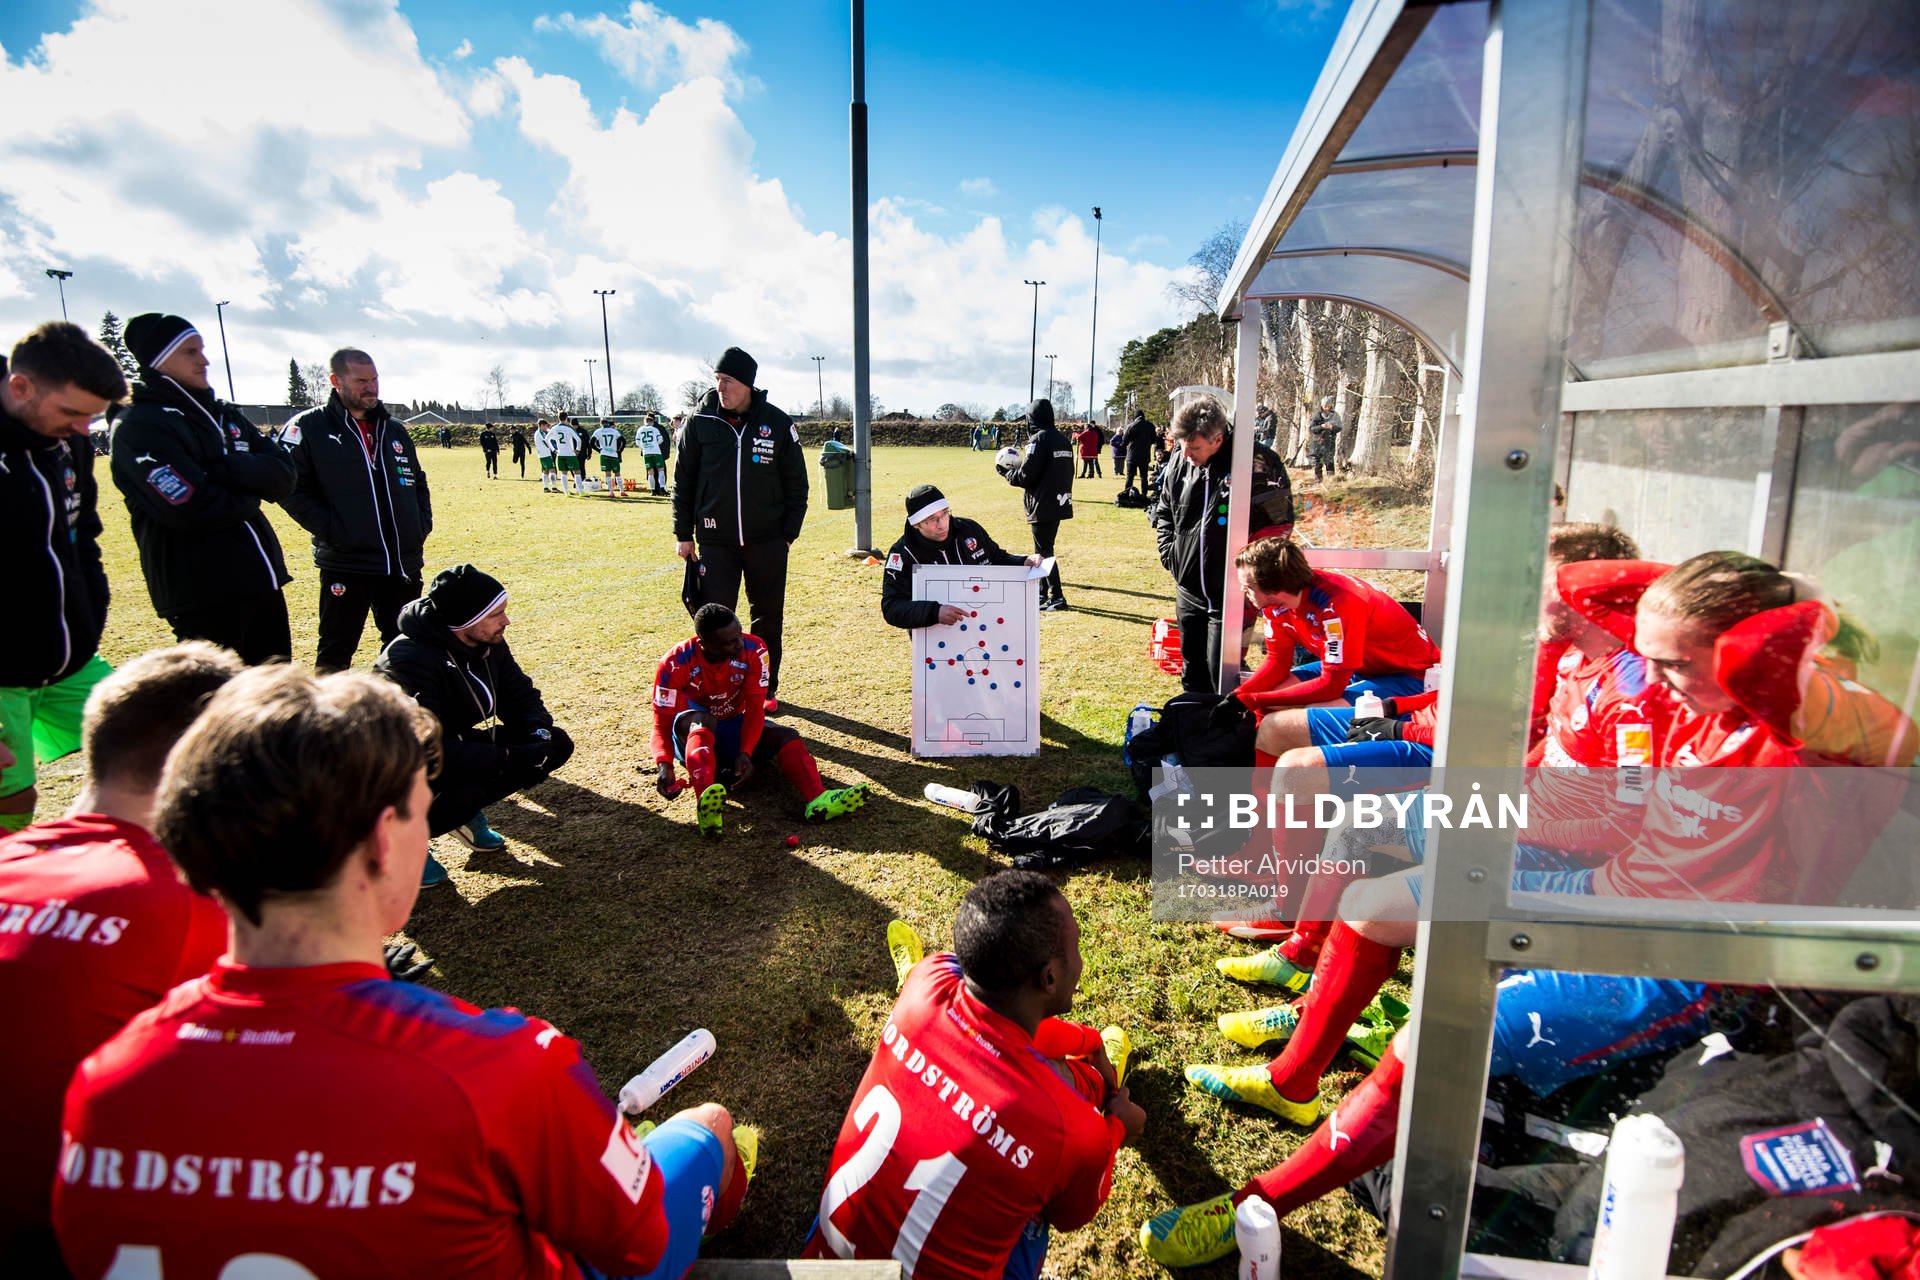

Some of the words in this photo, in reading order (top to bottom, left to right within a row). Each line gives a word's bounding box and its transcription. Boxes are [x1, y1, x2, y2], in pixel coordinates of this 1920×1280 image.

[558, 432, 566, 444] 2
[602, 434, 614, 447] 17
[641, 431, 654, 443] 25
[704, 518, 717, 529] DA
[659, 1055, 704, 1094] INTERSPORT
[882, 1013, 1034, 1169] ORDSTRÖMS
[62, 1130, 416, 1209] ORDSTRÖMS
[819, 1084, 968, 1280] 21
